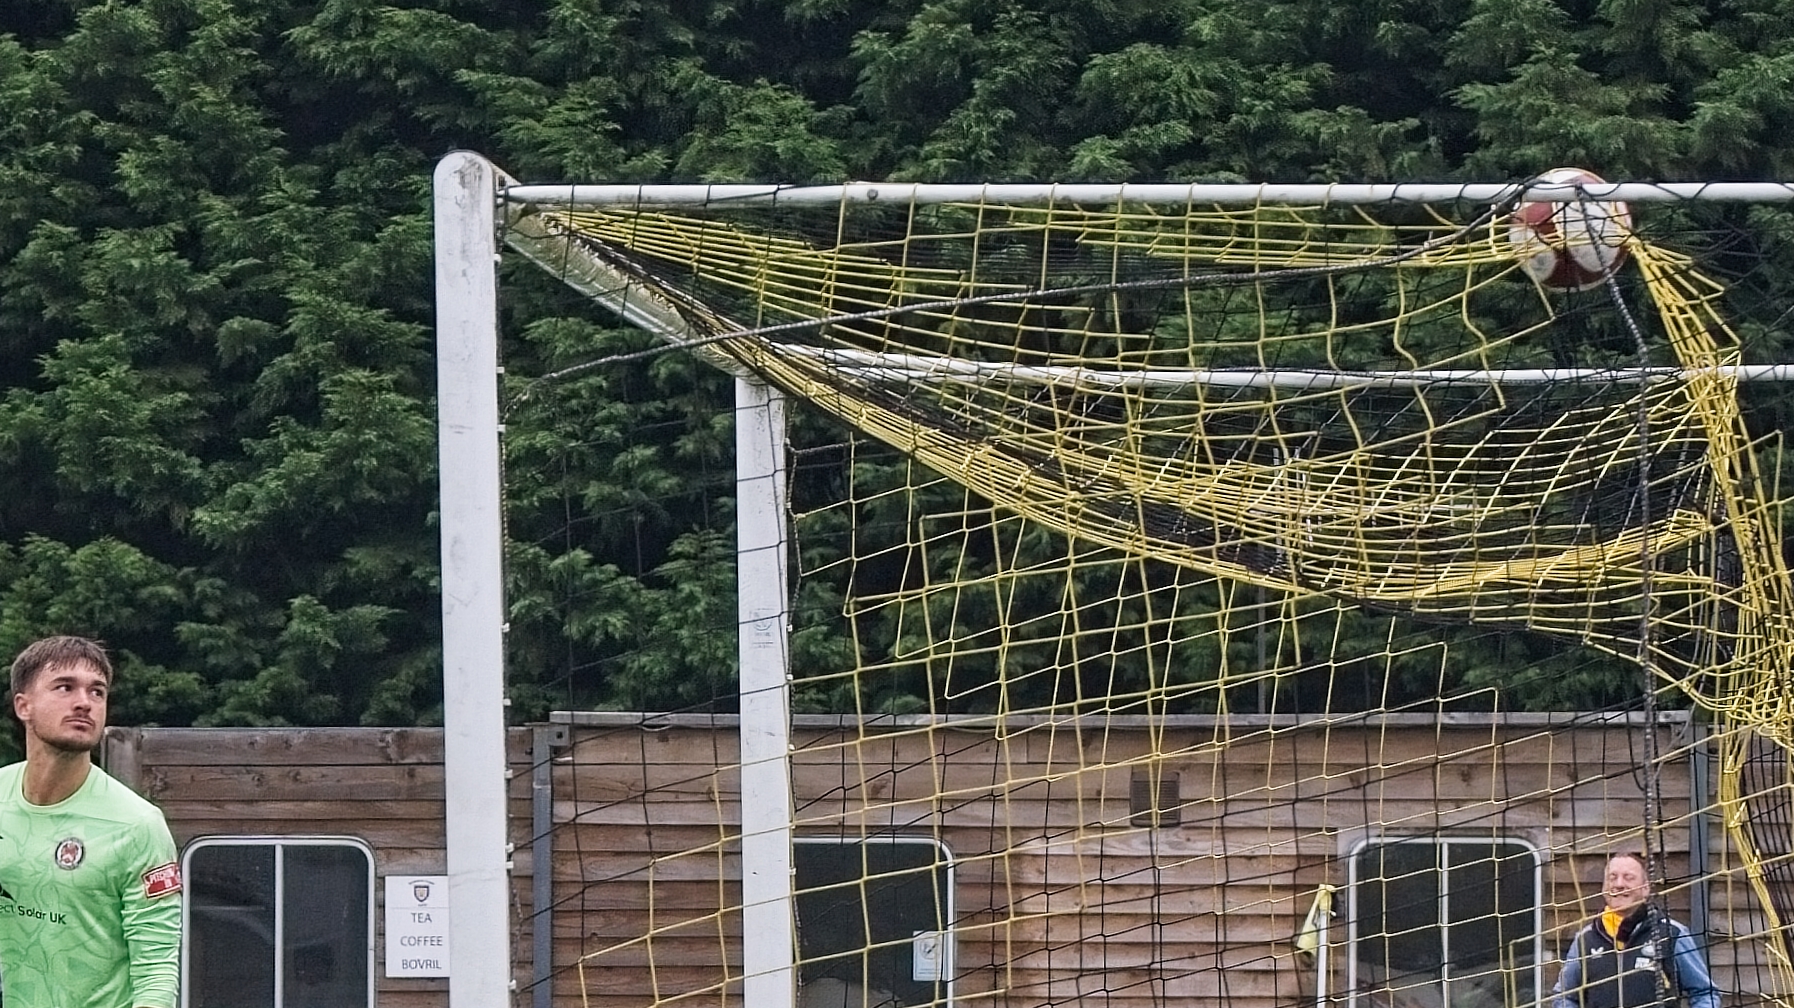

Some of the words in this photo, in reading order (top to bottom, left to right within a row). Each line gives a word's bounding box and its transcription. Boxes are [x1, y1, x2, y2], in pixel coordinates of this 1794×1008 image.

[17, 905, 46, 920] Solar
[49, 911, 67, 925] UK
[411, 912, 433, 923] TEA
[400, 935, 443, 946] COFFEE
[402, 959, 442, 970] BOVRIL
